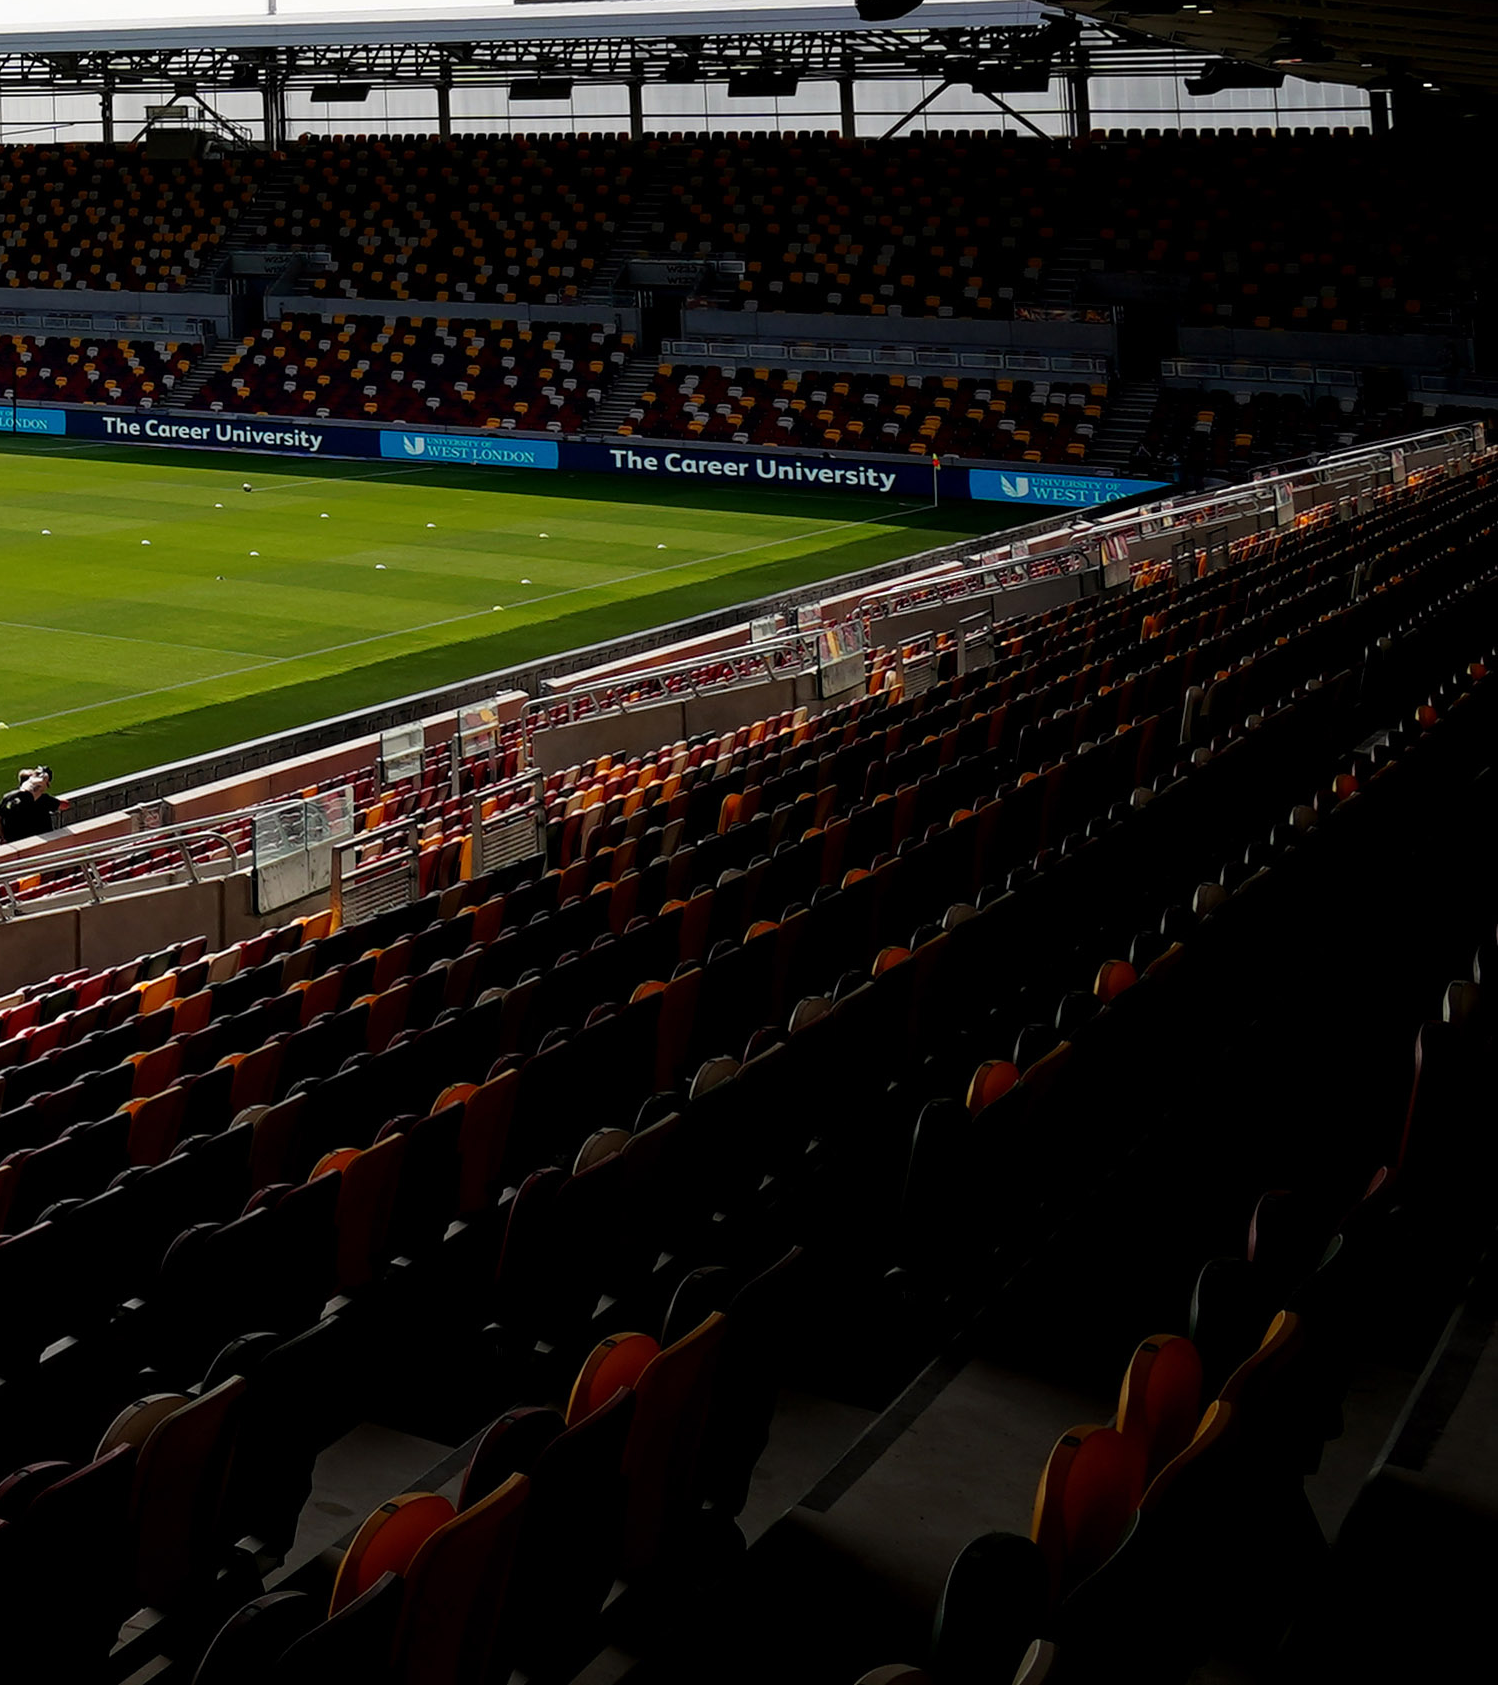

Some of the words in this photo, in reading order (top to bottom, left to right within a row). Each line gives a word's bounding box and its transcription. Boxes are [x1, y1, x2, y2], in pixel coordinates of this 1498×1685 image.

[102, 416, 141, 436] The
[144, 419, 211, 441] Career
[215, 423, 323, 452] University
[426, 437, 479, 448] UNIVERSITY
[480, 440, 493, 449] OF
[426, 444, 469, 459] WEST
[472, 447, 536, 464] LONDON
[609, 449, 659, 471] The
[664, 453, 750, 477] Career
[755, 458, 897, 493] University
[1031, 477, 1102, 491] UNIVERSITY
[1104, 481, 1121, 492] OF
[1031, 487, 1090, 503] WEST
